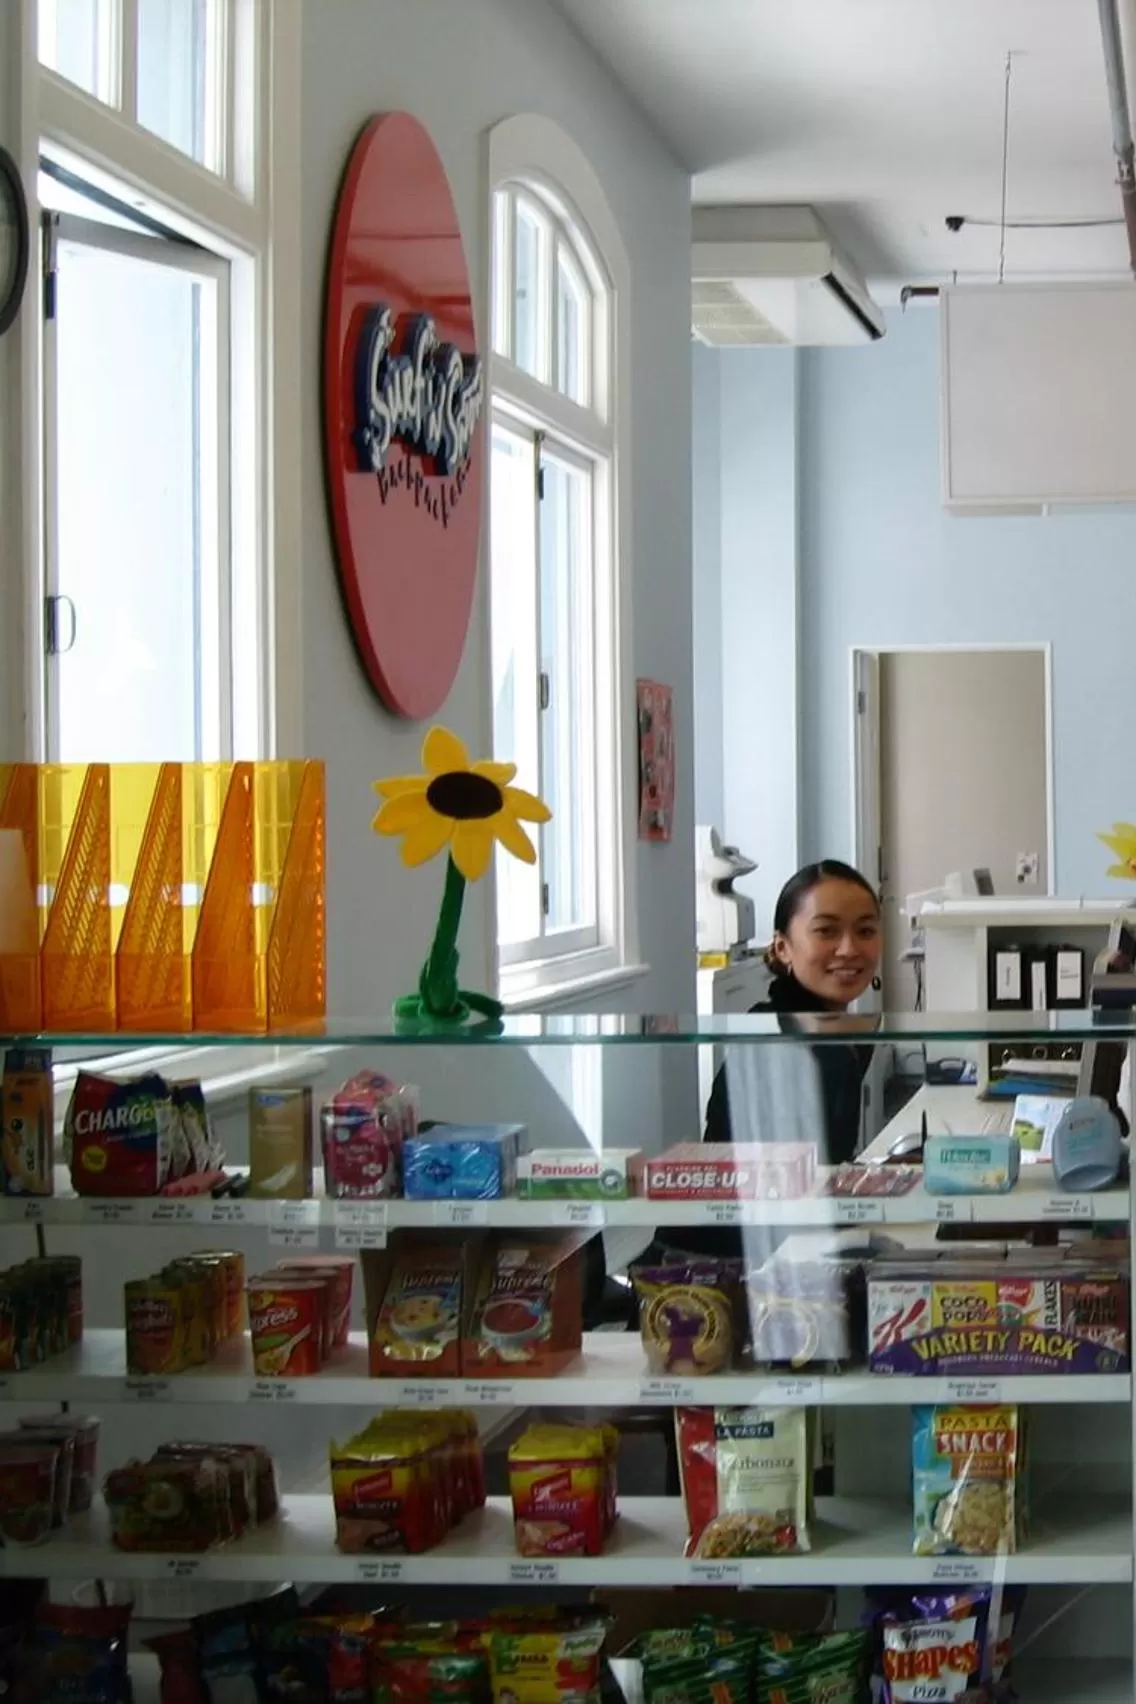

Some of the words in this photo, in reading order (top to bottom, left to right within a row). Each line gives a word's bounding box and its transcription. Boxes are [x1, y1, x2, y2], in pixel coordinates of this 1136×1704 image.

[531, 1163, 600, 1177] Panadol
[912, 1329, 1012, 1361] VARIETY
[1017, 1330, 1081, 1361] PACK
[941, 1415, 1008, 1429] PASTA
[940, 1430, 1007, 1453] SNACK
[912, 1683, 947, 1699] Pizza
